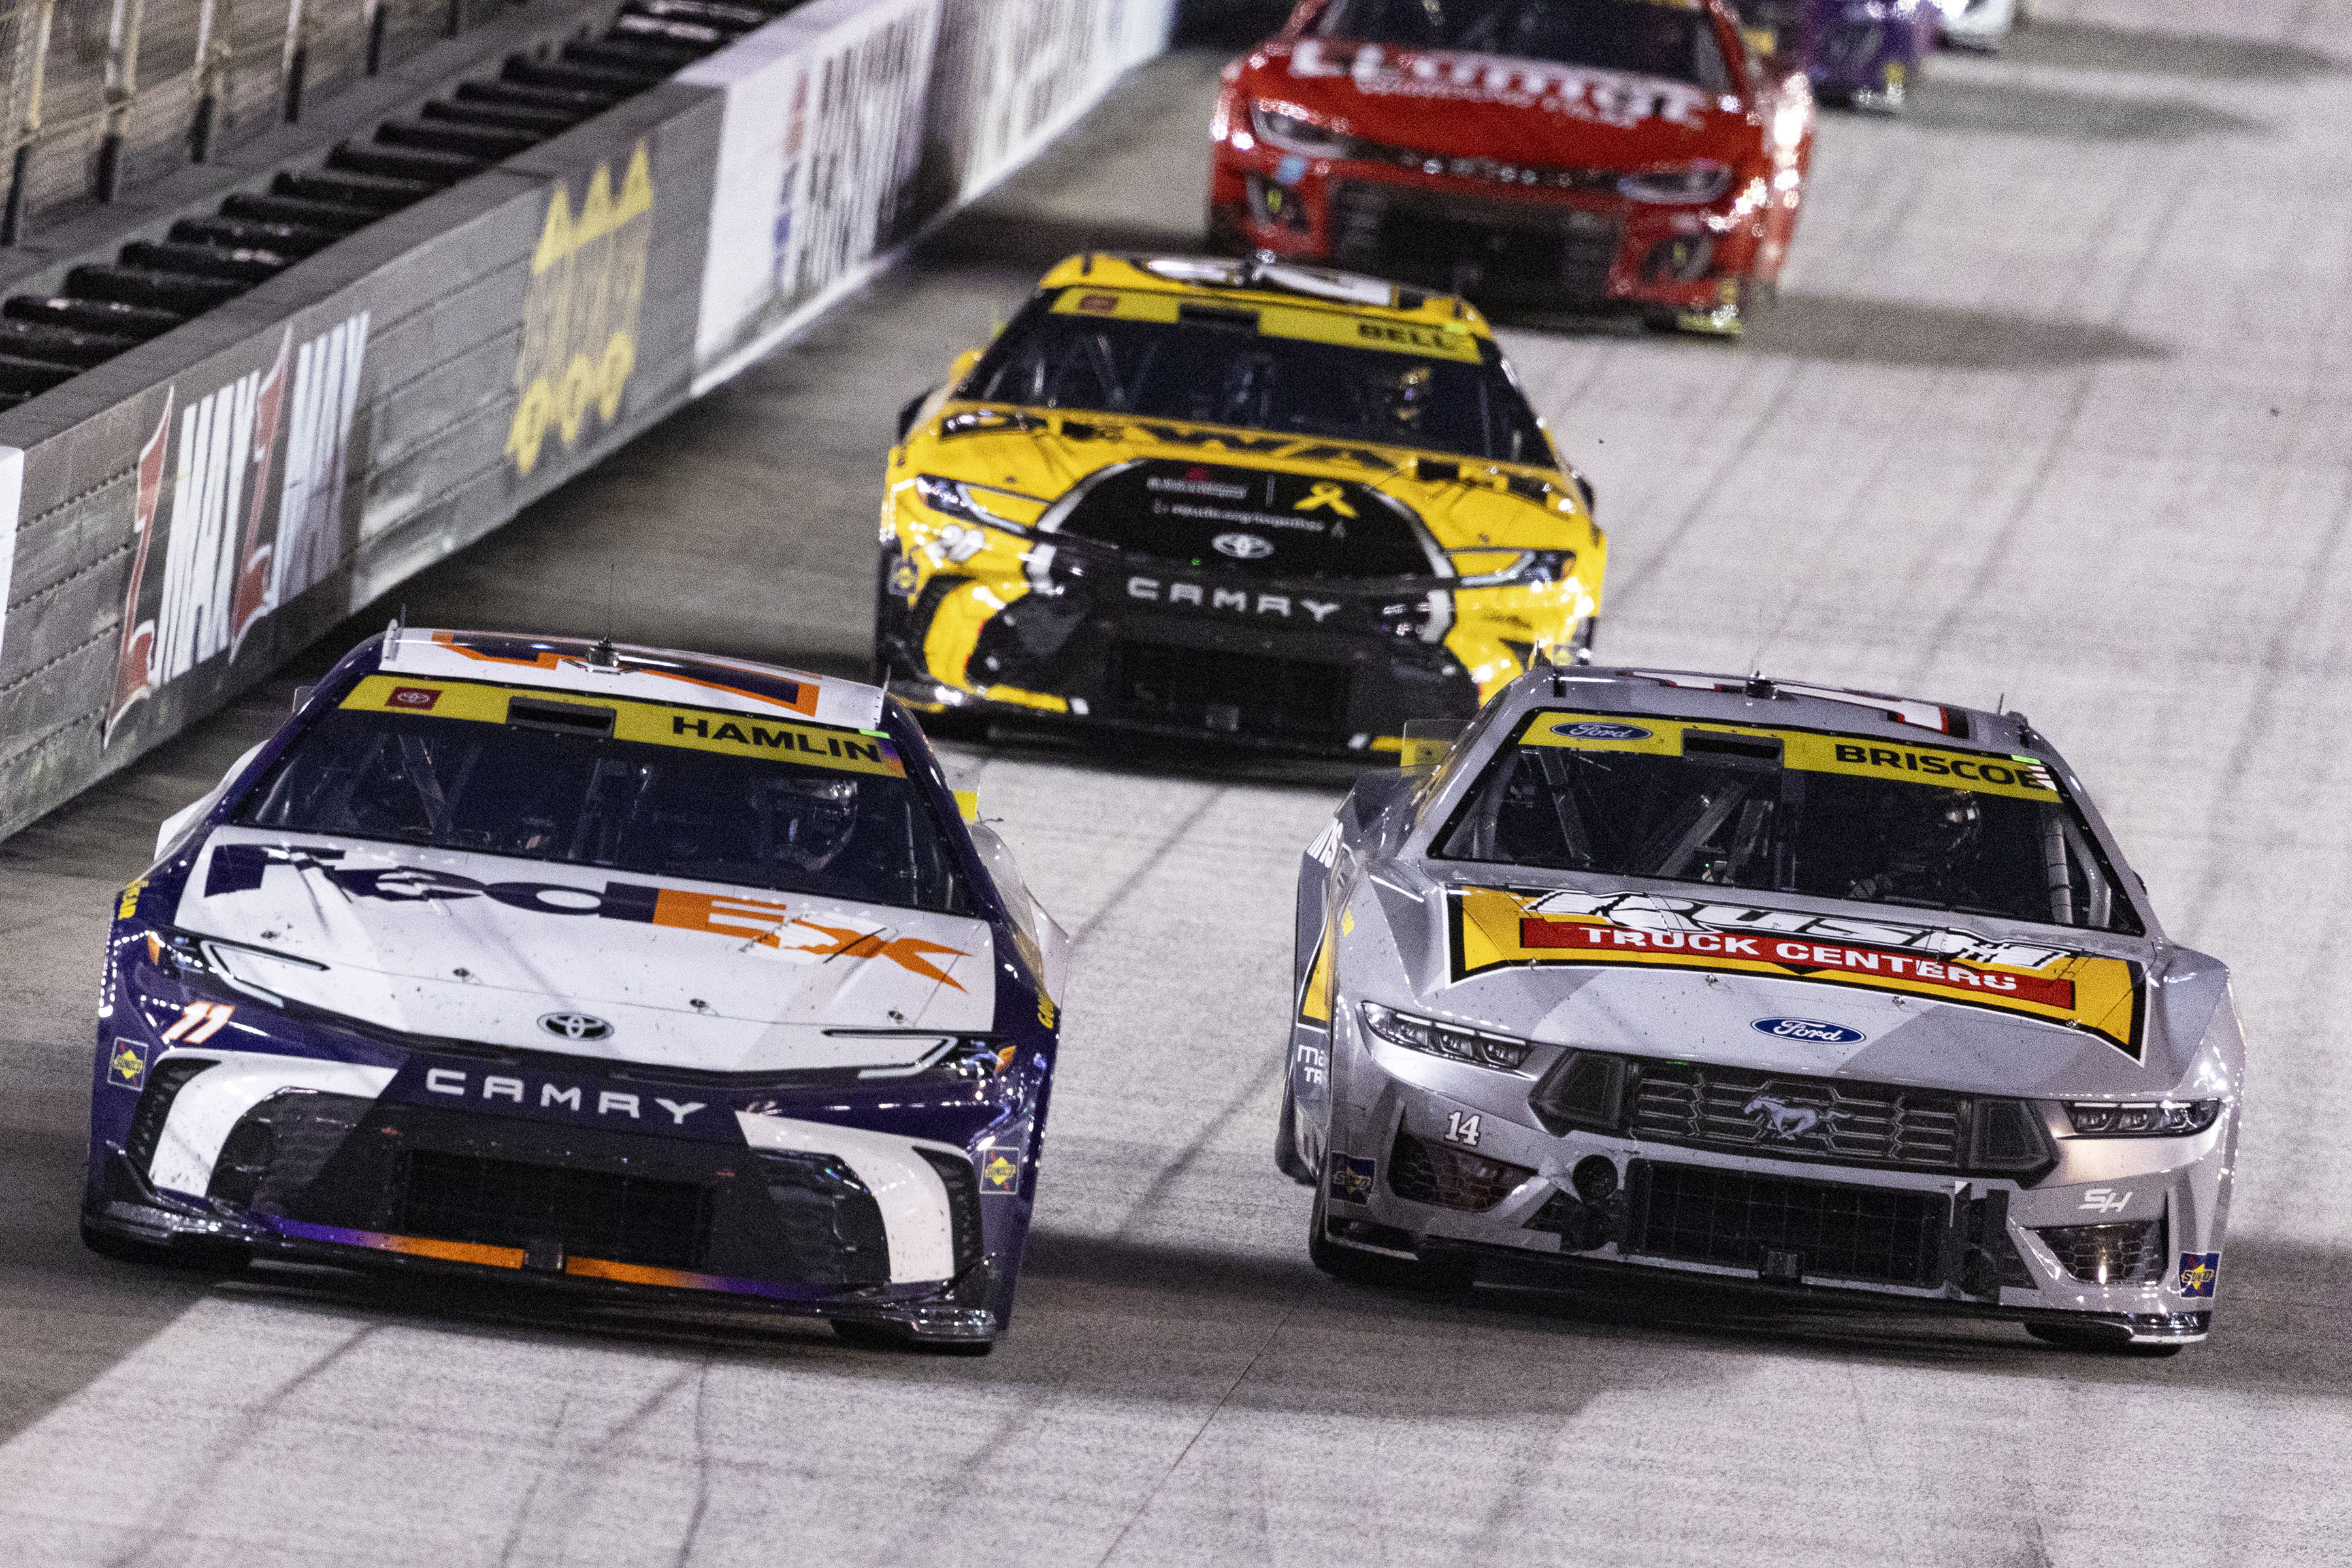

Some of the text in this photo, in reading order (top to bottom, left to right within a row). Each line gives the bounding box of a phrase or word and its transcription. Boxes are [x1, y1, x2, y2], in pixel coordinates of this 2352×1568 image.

[1358, 322, 1454, 351] BELL
[1128, 576, 1341, 621] CAMRY
[673, 715, 882, 763] HAMLIN
[1835, 743, 2046, 790] BRISCOE
[1584, 927, 2018, 991] TRUCK CENTERS
[161, 1001, 235, 1044] 11
[426, 1068, 707, 1124] CAMRY
[1443, 1110, 1481, 1146] 14
[2078, 1188, 2134, 1213] SH
